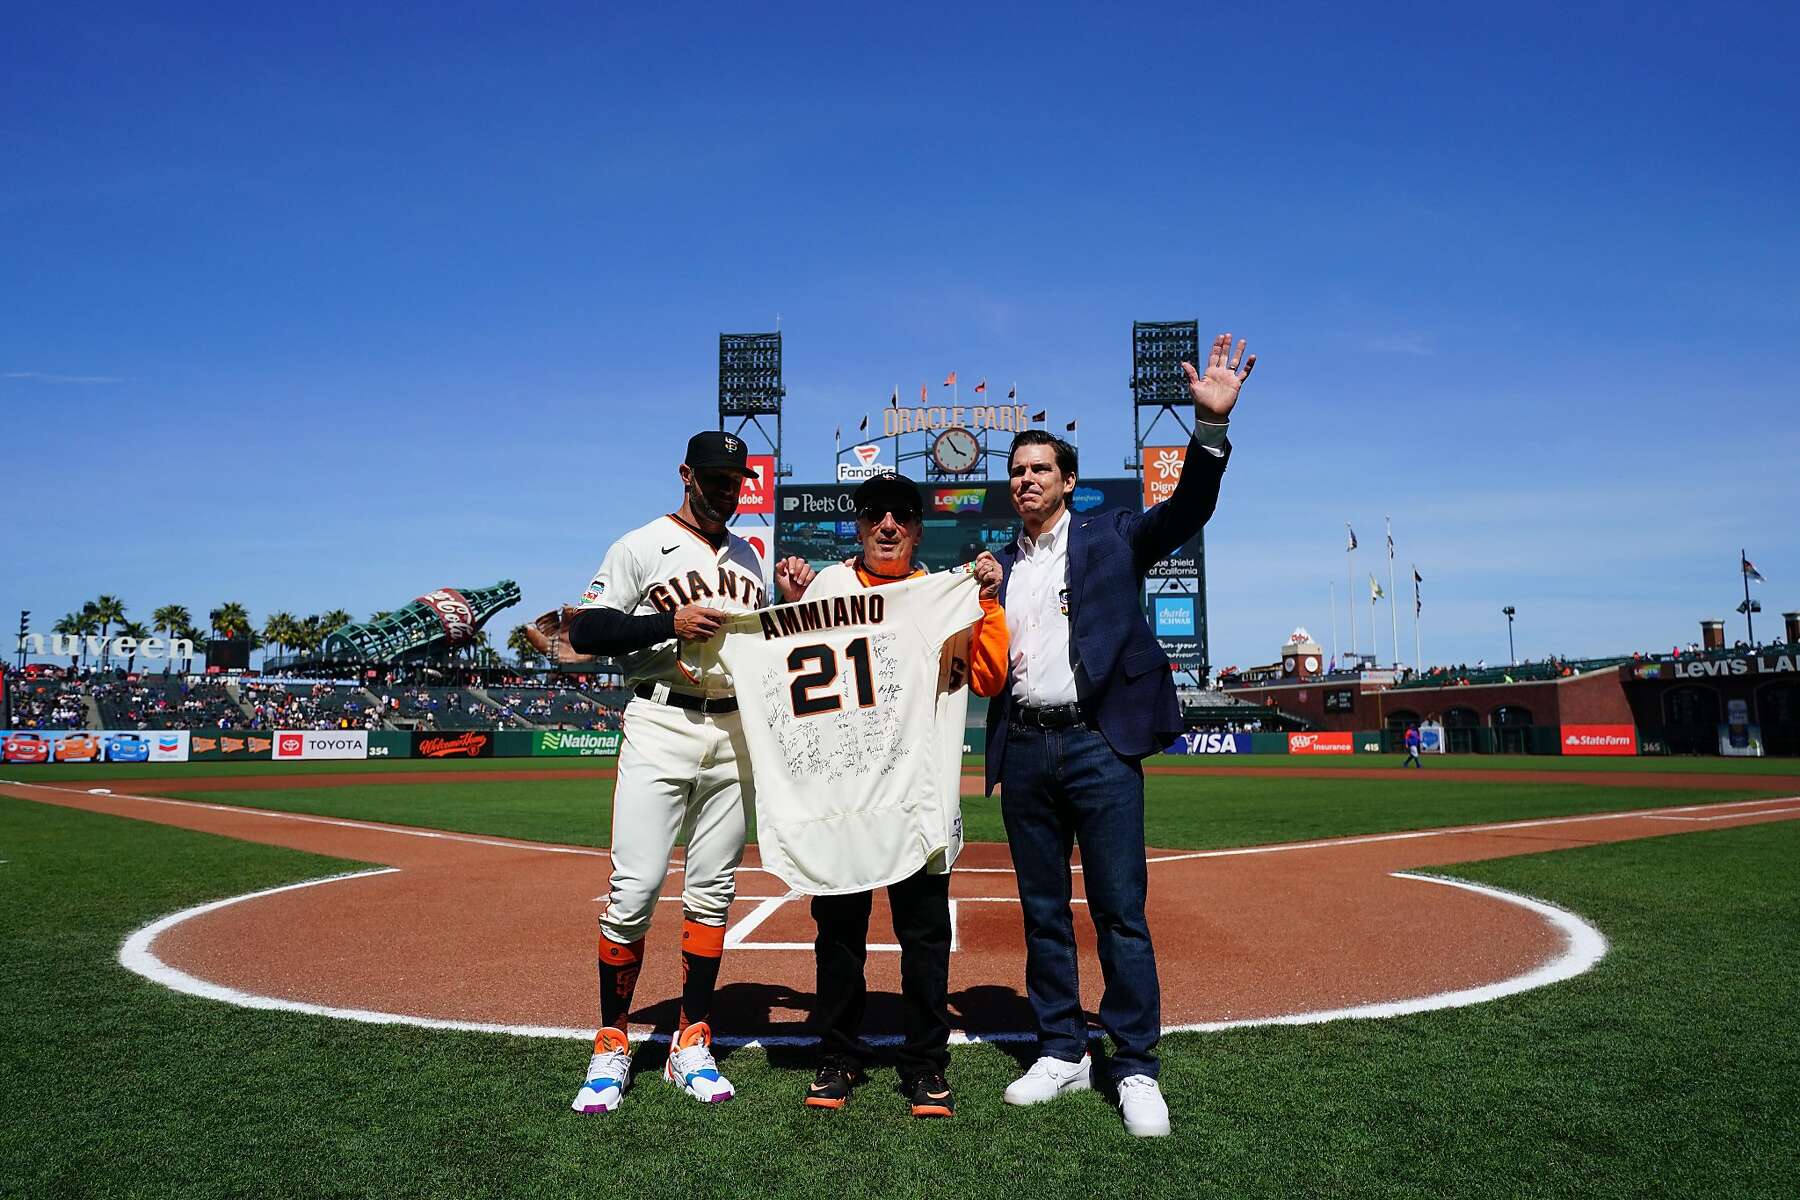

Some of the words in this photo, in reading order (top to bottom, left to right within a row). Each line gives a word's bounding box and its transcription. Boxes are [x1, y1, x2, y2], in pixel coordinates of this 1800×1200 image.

[884, 407, 965, 436] ORACLE
[973, 405, 1028, 432] PARK
[738, 494, 763, 504] dobe
[1170, 559, 1194, 567] Shield
[1149, 567, 1157, 575] of
[1159, 567, 1198, 575] California
[758, 594, 885, 641] AMMIANO
[18, 632, 194, 660] nuveen
[787, 637, 876, 718] 21
[309, 740, 362, 750] TOYOTA
[560, 734, 619, 749] National
[1191, 734, 1238, 753] VISA
[1643, 742, 1660, 751] 365
[369, 747, 388, 755] 354
[1313, 743, 1351, 751] Insurance
